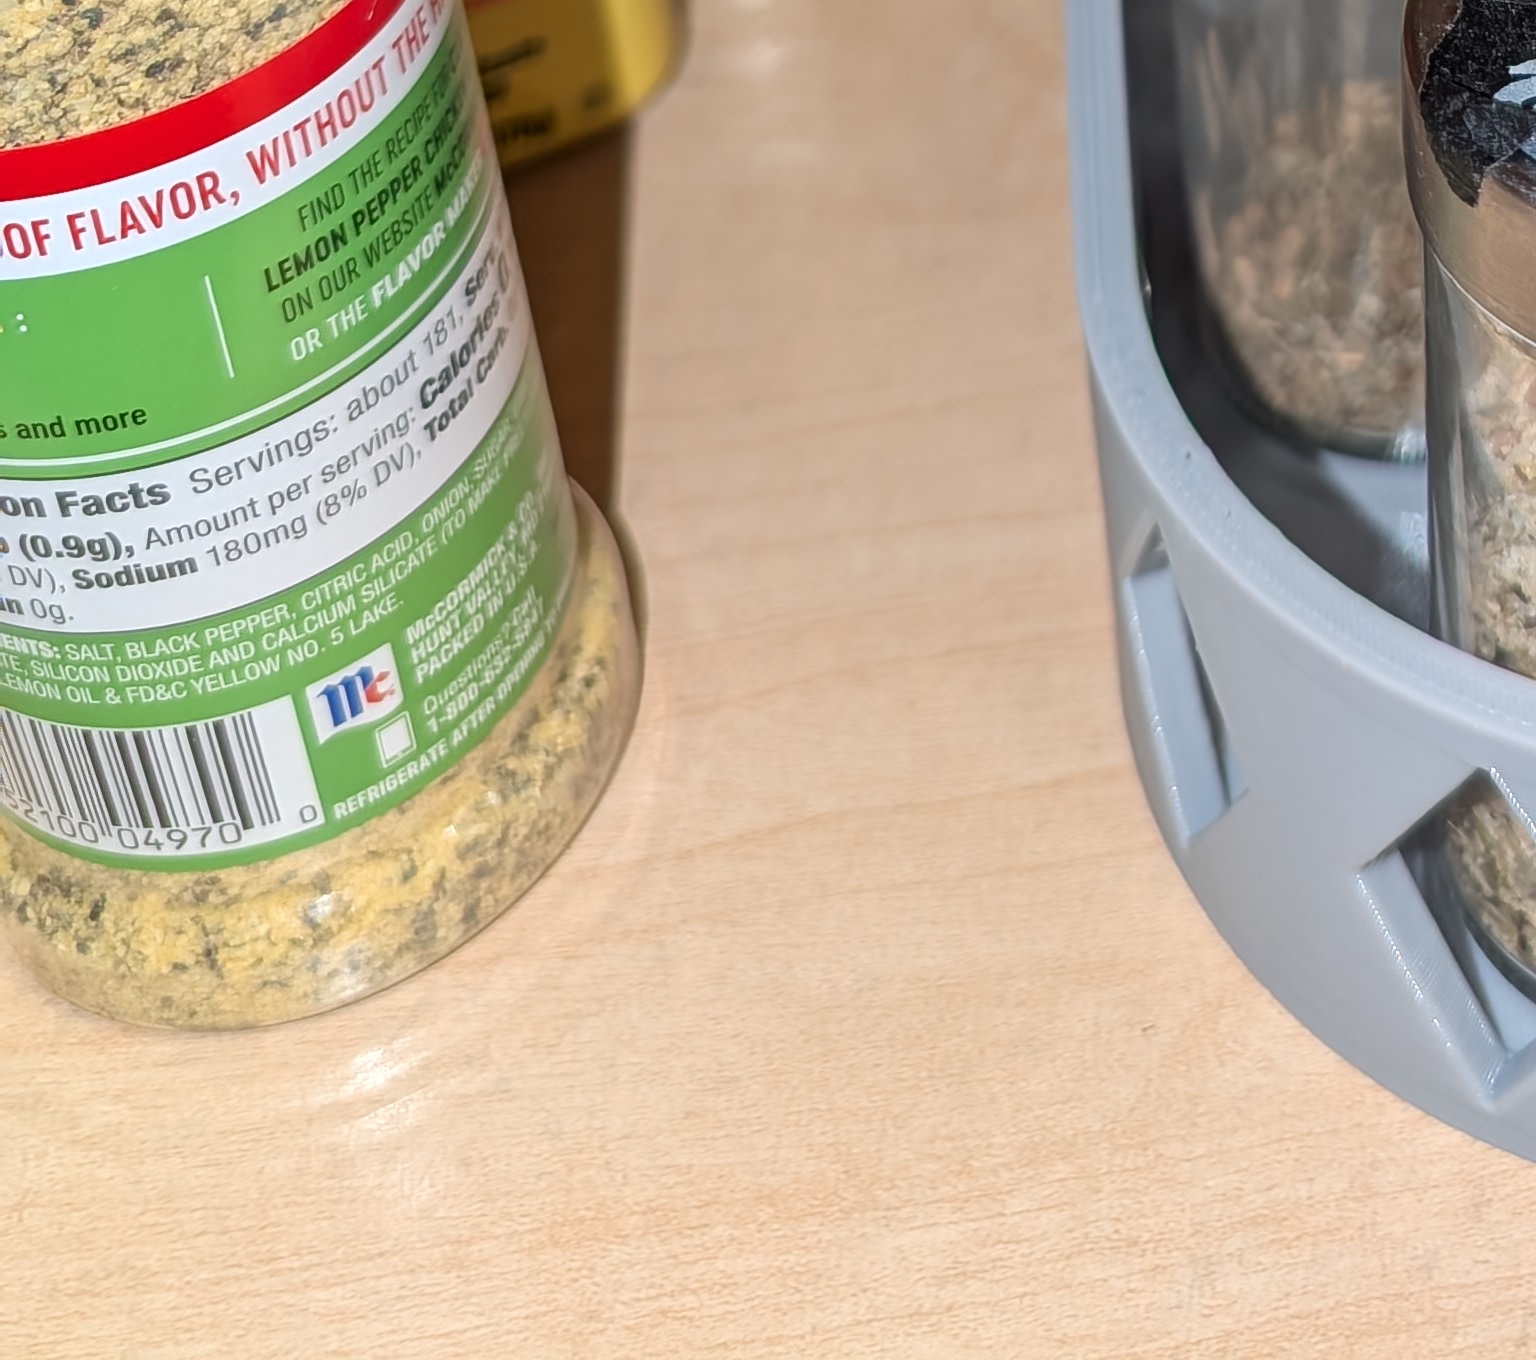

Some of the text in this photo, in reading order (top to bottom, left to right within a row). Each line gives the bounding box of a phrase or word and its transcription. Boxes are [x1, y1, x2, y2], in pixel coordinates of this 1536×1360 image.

[3, 218, 51, 260] OF
[66, 170, 241, 251] FLAVOR,
[245, 54, 389, 186] WITHOUT
[391, 4, 430, 76] THE
[298, 181, 346, 233] FIND
[348, 150, 384, 195] THE
[385, 95, 432, 165] RECIPE
[263, 220, 349, 293] LEMON
[351, 155, 424, 237] PEPPER
[281, 287, 314, 324] ON
[318, 256, 361, 301] OUR
[362, 184, 435, 269] WEBSITE
[289, 327, 323, 362] OR
[326, 294, 369, 340] THE
[370, 220, 447, 310] FLAVOR
[7, 563, 67, 595] DV),
[71, 555, 199, 591] Sodium
[205, 512, 309, 568] 180mg
[316, 477, 369, 527] (8%
[372, 440, 422, 488] DV),
[422, 376, 475, 443] Total
[16, 414, 67, 440] and
[74, 407, 148, 437] more
[18, 531, 136, 563] (0.9g),
[144, 497, 262, 551] Amount
[268, 473, 313, 516] per
[320, 405, 416, 484] serving:
[419, 292, 502, 410] Calories
[54, 481, 172, 519] Facts
[188, 414, 339, 495] Servings:
[346, 347, 419, 422] about
[29, 597, 75, 626] 0g.
[32, 658, 111, 684] SILICON
[114, 654, 205, 684] DIOXIDE
[208, 640, 256, 670] AND
[261, 593, 357, 652] CALCIUM
[360, 533, 439, 604] SILICATE
[441, 508, 467, 546] (TO
[65, 642, 122, 663] SALT,
[124, 631, 202, 660] BLACK
[204, 602, 298, 647] PEPPER,
[301, 562, 368, 611] CITRIC
[370, 530, 420, 574] ACID,
[420, 476, 475, 533] ONION,
[410, 608, 463, 664] HUNT
[66, 685, 101, 705] OIL
[104, 687, 122, 705] &
[125, 680, 189, 704] FD&C
[189, 653, 283, 696] YELLOW
[286, 638, 327, 667] NO.
[329, 625, 345, 646] 5
[348, 591, 405, 637] LAKE.
[415, 613, 485, 685] PACKED
[332, 737, 449, 820] REFRIGERATE
[451, 695, 497, 748] AFTER
[116, 821, 243, 852] 04970
[299, 804, 319, 825] 0
